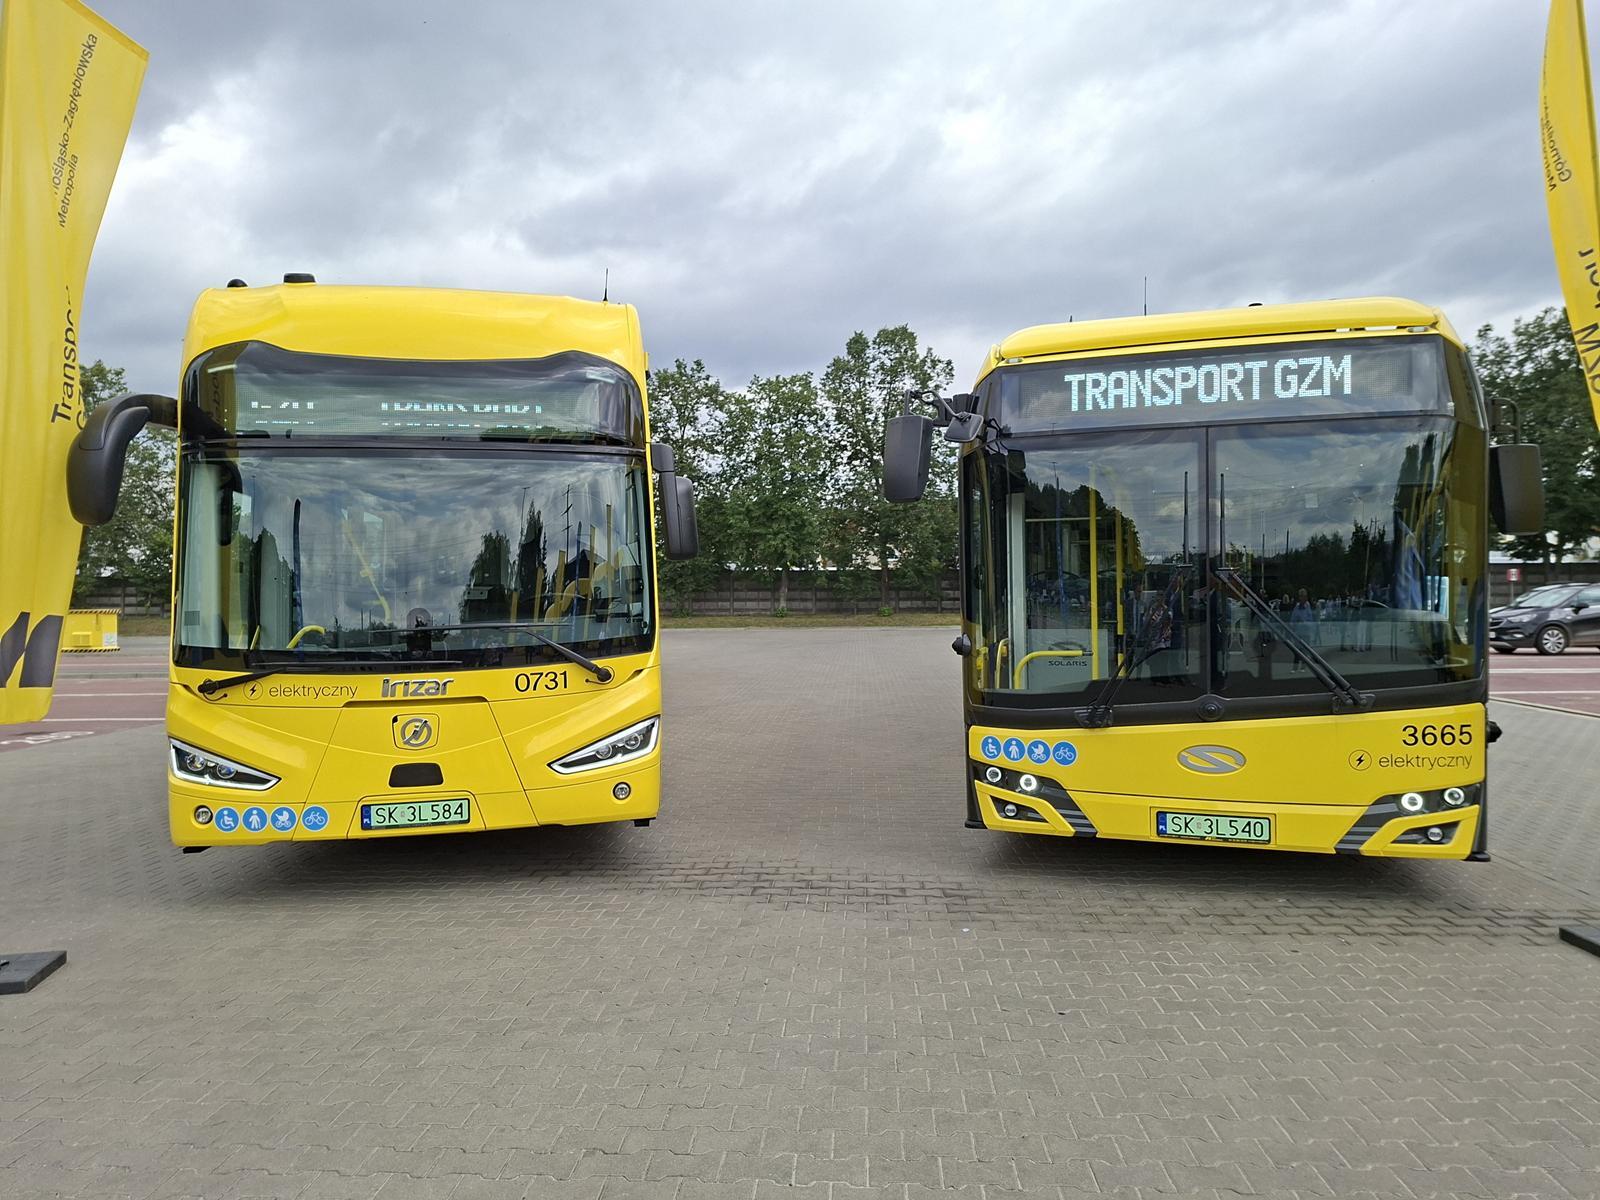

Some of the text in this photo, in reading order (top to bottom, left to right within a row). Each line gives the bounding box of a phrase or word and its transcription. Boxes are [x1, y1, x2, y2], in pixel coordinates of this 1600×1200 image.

[51, 33, 98, 196] ośląsko-Zagłębiowska
[58, 154, 78, 228] Metropolia
[1064, 354, 1352, 412] TRANSPORT GZM
[268, 683, 358, 699] elektryczny
[515, 671, 568, 692] 0731
[1402, 724, 1472, 746] 3665
[1378, 753, 1472, 771] elektryczny
[375, 807, 398, 824] SK
[407, 802, 463, 822] 3L584
[1171, 816, 1194, 834] SK
[1204, 818, 1264, 838] 3L540
